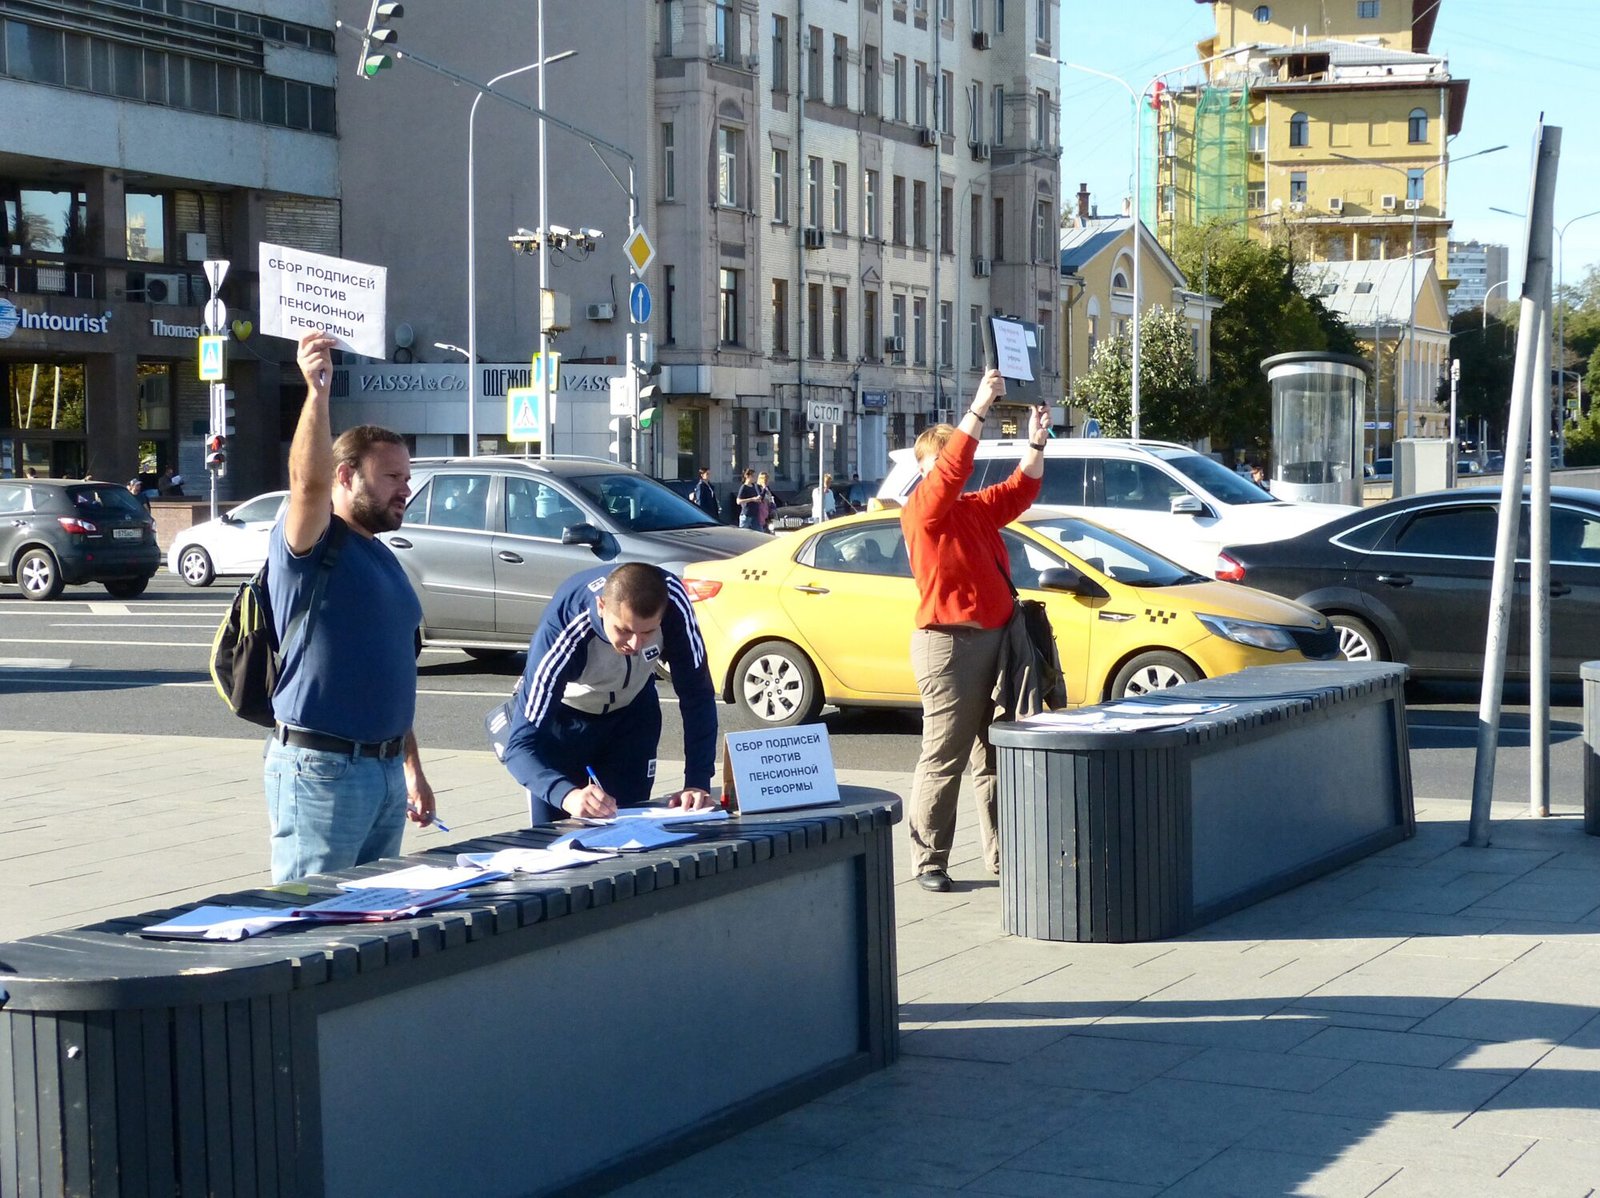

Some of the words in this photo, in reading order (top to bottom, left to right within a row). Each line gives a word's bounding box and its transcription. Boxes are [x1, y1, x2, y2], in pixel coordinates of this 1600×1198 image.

[268, 258, 303, 274] СБОР
[306, 266, 375, 290] ПОДПИСЕЙ
[296, 281, 347, 301] ПРОТИВ
[279, 295, 365, 323] ПЕНСИОННОЙ
[22, 308, 108, 334] Intourist
[150, 319, 199, 338] Thomas
[290, 315, 354, 338] РЕФОРМЫ
[563, 375, 611, 392] VASS
[813, 404, 839, 421] СТОП
[735, 740, 763, 752] СБОР
[765, 732, 821, 749] ПОДПИСЕЙ
[760, 751, 802, 765] ПРОТИВ
[749, 764, 819, 782] ПЕНСИОННОЙ
[760, 781, 813, 796] РЕФОРМЫ
